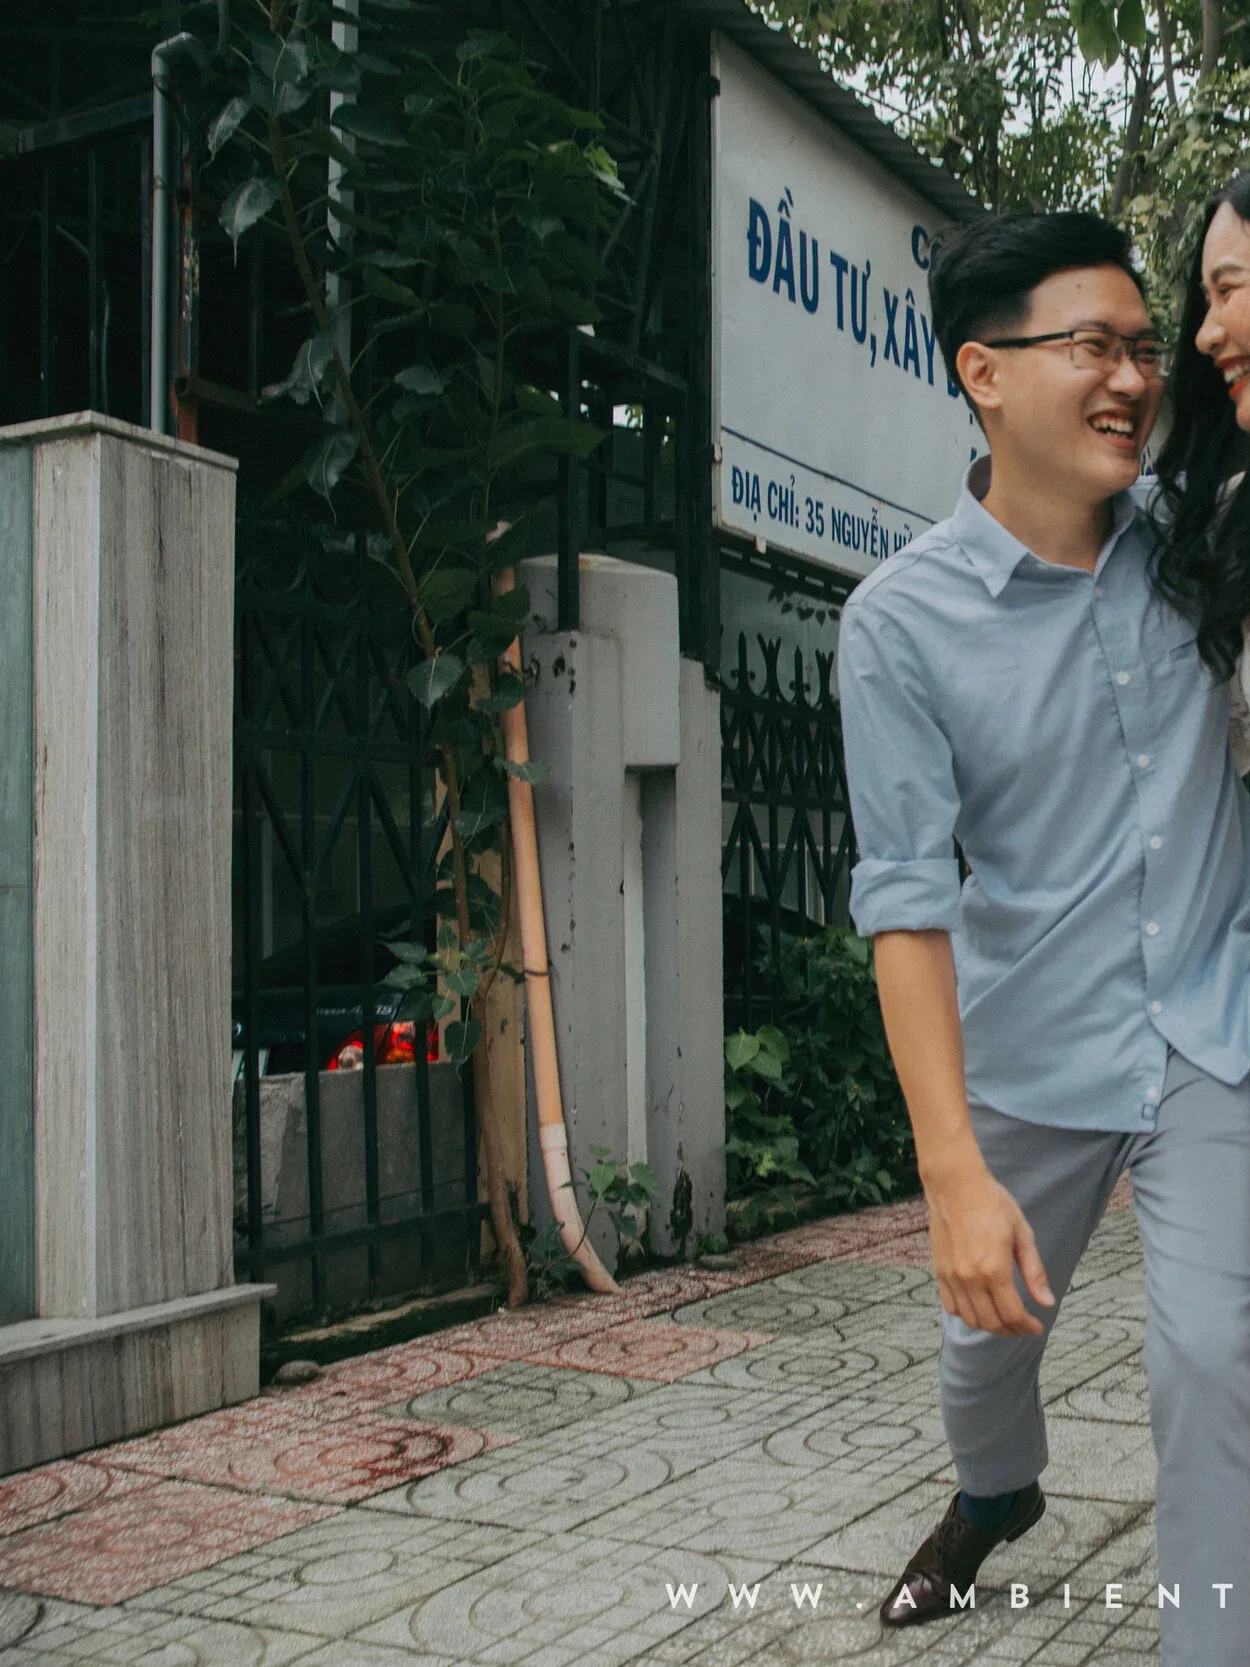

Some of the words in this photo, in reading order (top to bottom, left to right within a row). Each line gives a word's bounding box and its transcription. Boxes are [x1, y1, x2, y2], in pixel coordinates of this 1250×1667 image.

[747, 185, 819, 314] ĐẦU
[883, 287, 936, 387] XÂY
[767, 474, 799, 528] CHỈ:
[805, 496, 825, 537] 35
[831, 506, 889, 560] NGUYỄN
